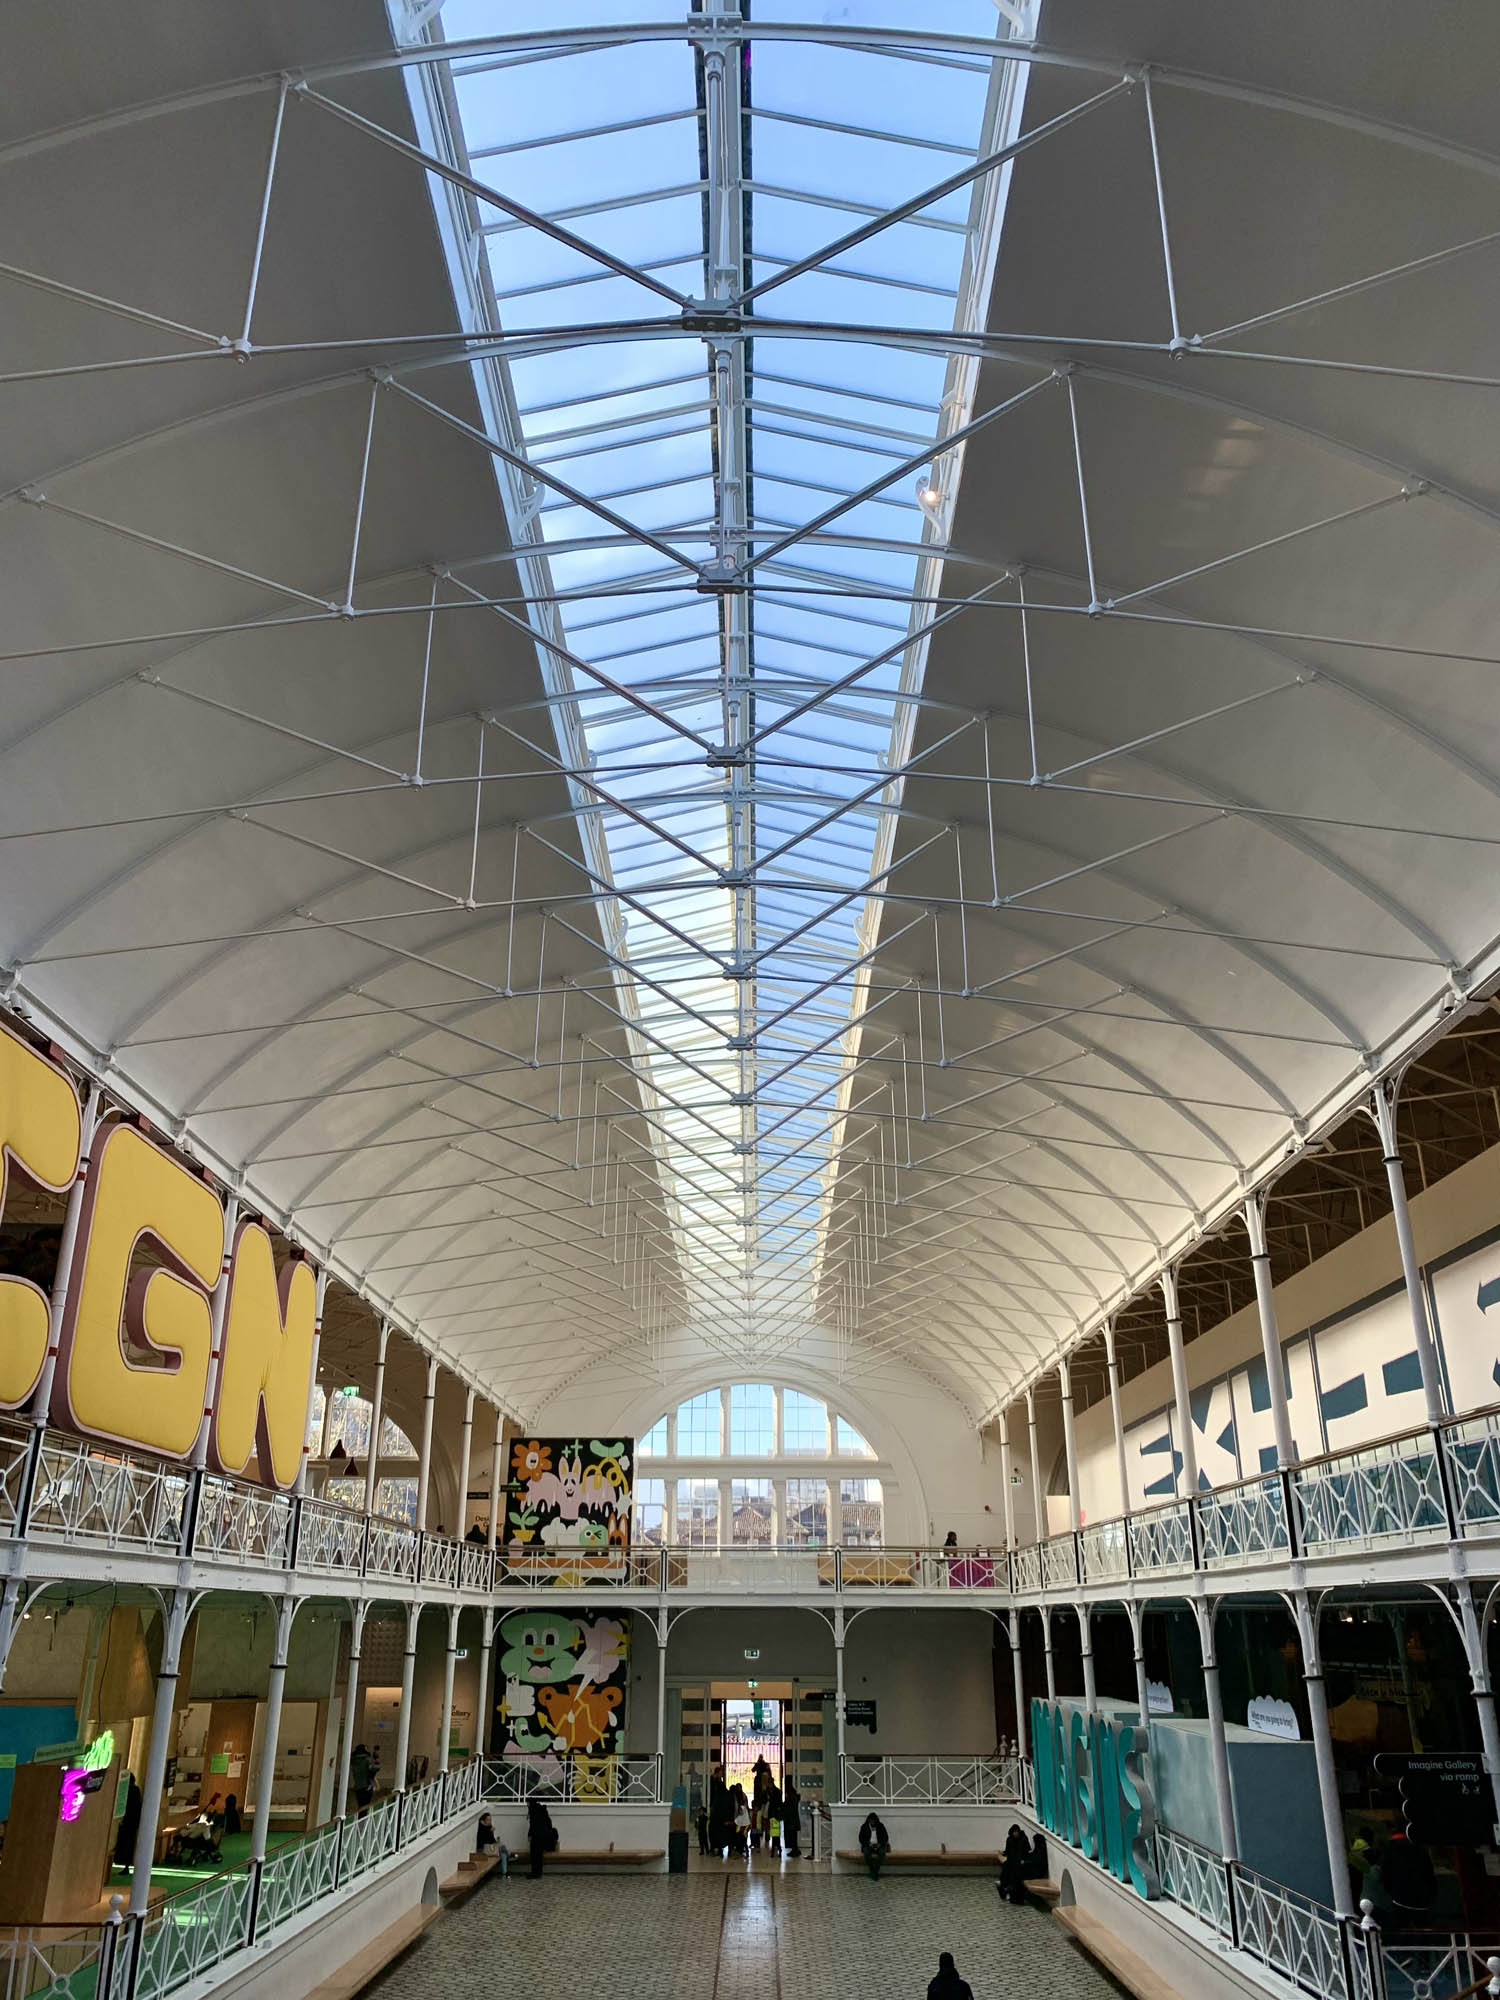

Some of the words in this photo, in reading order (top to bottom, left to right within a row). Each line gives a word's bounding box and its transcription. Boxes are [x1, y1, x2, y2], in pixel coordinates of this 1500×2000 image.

[1408, 1760, 1444, 1771] Imagine
[1445, 1760, 1477, 1771] Gallery
[1440, 1773, 1453, 1781] via
[1455, 1773, 1480, 1782] ramp
